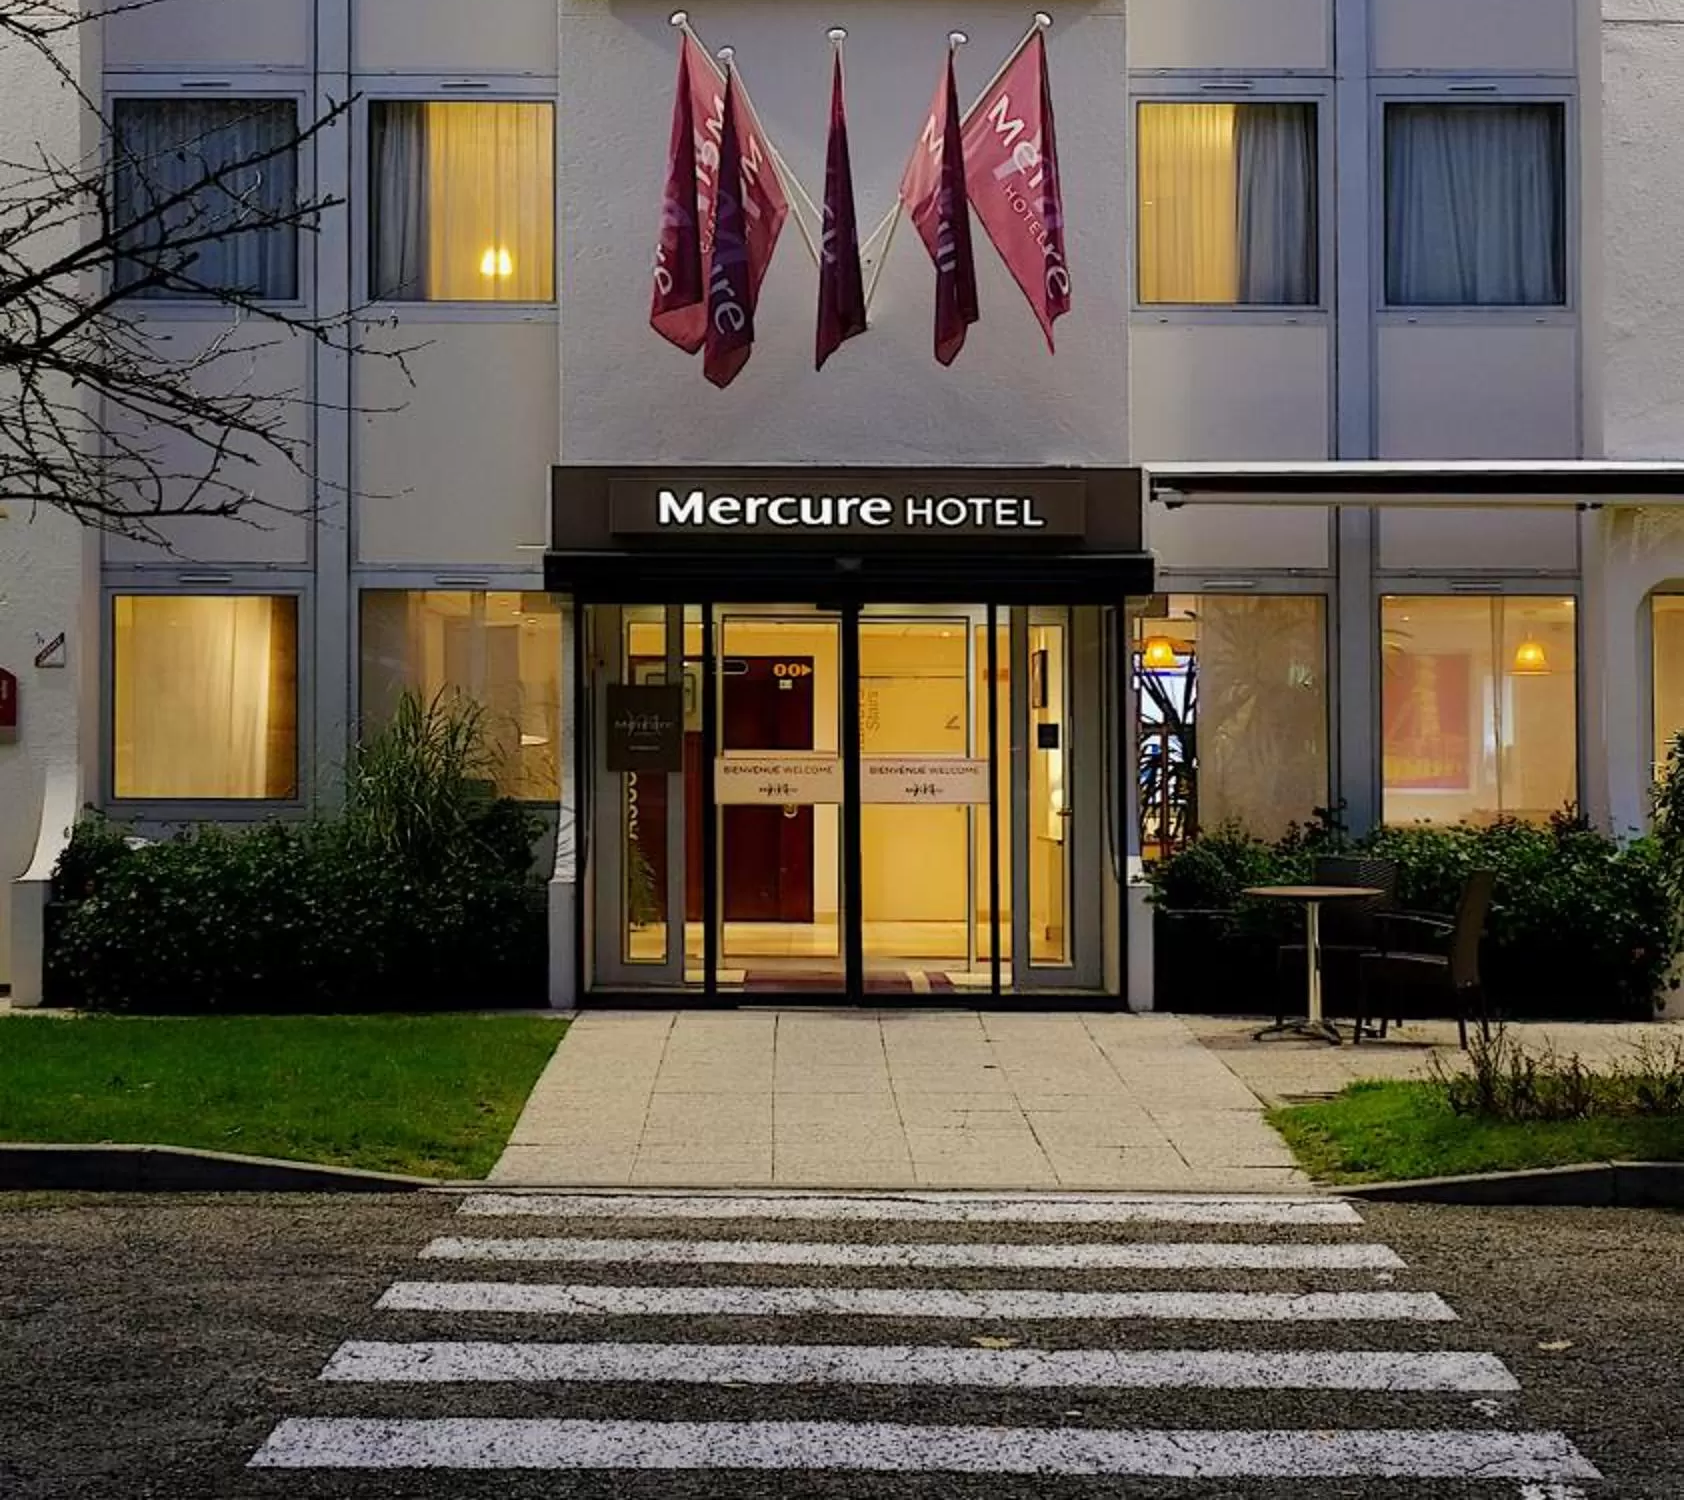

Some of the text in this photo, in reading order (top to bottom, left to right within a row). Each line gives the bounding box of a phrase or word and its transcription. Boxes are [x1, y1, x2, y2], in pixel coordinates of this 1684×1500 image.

[658, 490, 1046, 527] Mercure HOTEL
[723, 764, 834, 776] BIENVENUE WELCOME
[928, 764, 980, 775] WELCOME
